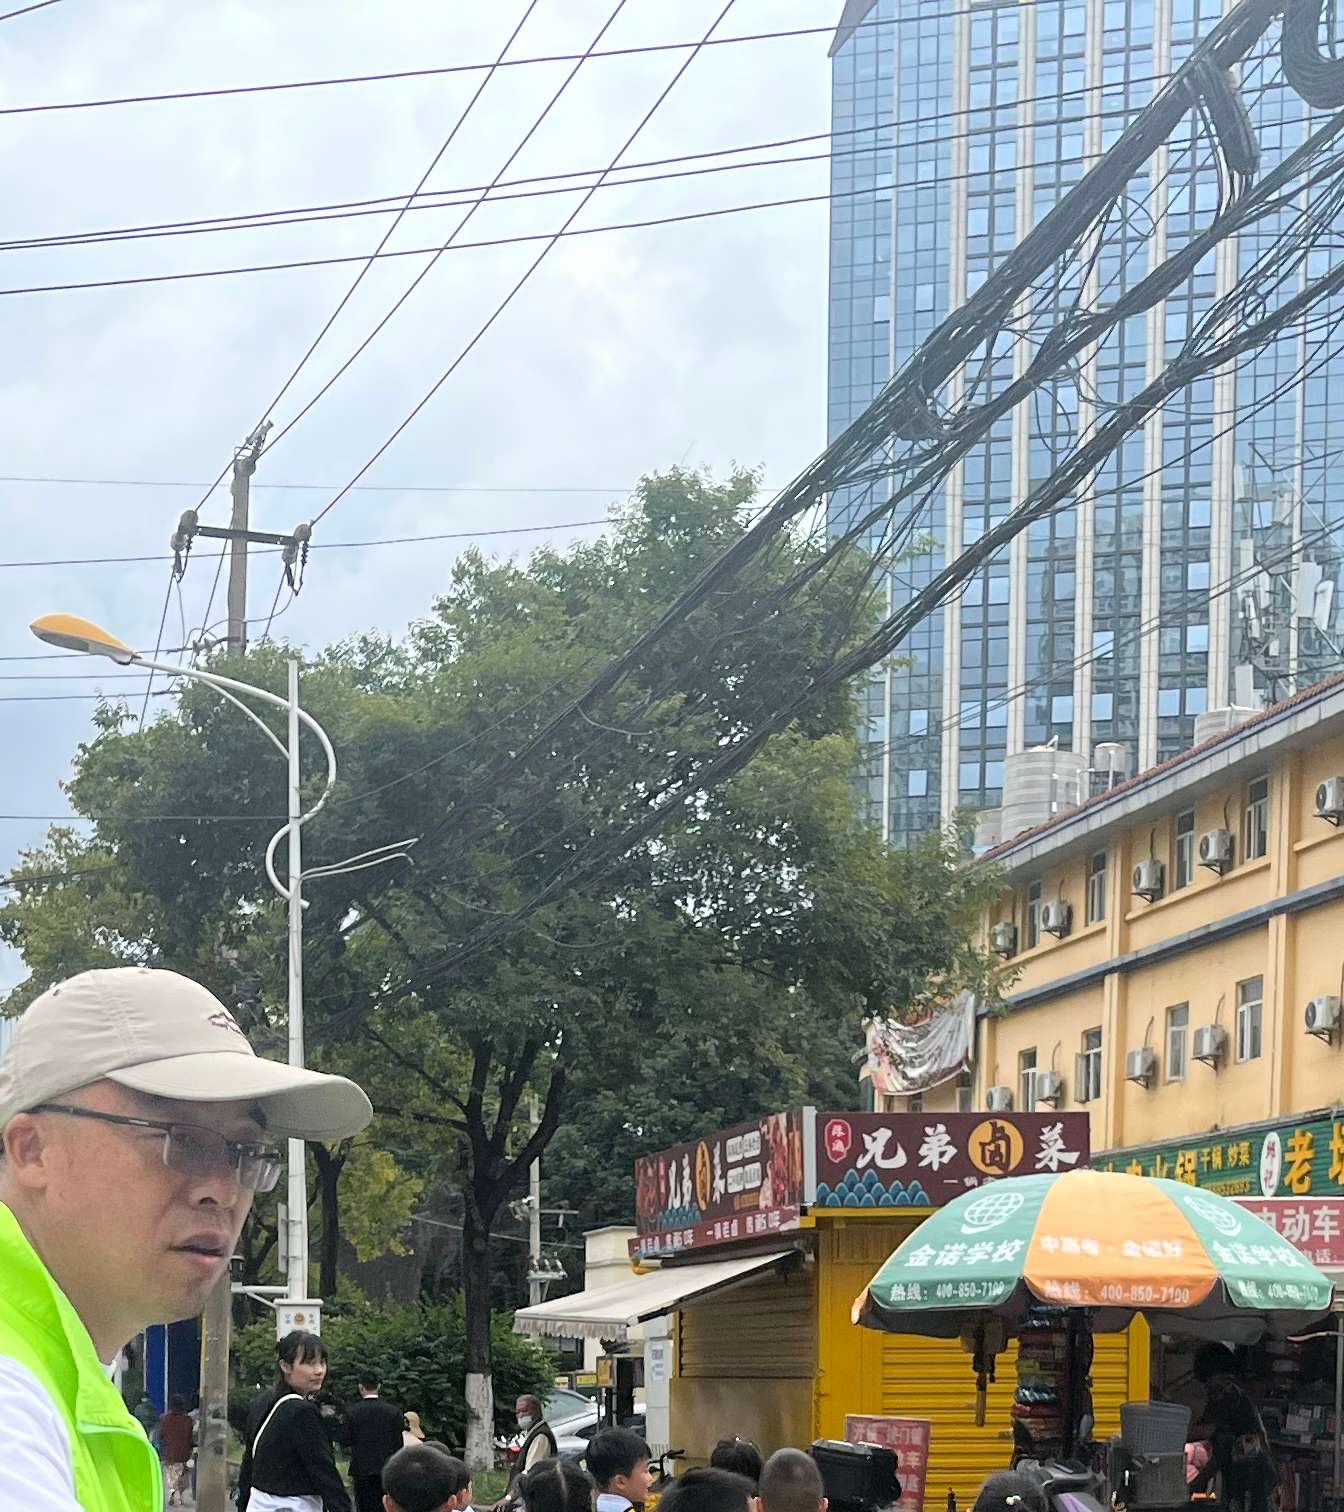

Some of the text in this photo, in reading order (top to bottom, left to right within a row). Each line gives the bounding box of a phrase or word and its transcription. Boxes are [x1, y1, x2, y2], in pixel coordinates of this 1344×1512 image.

[856, 1121, 1081, 1172] 兄弟卤菜
[905, 1240, 1024, 1267] 金诺学校
